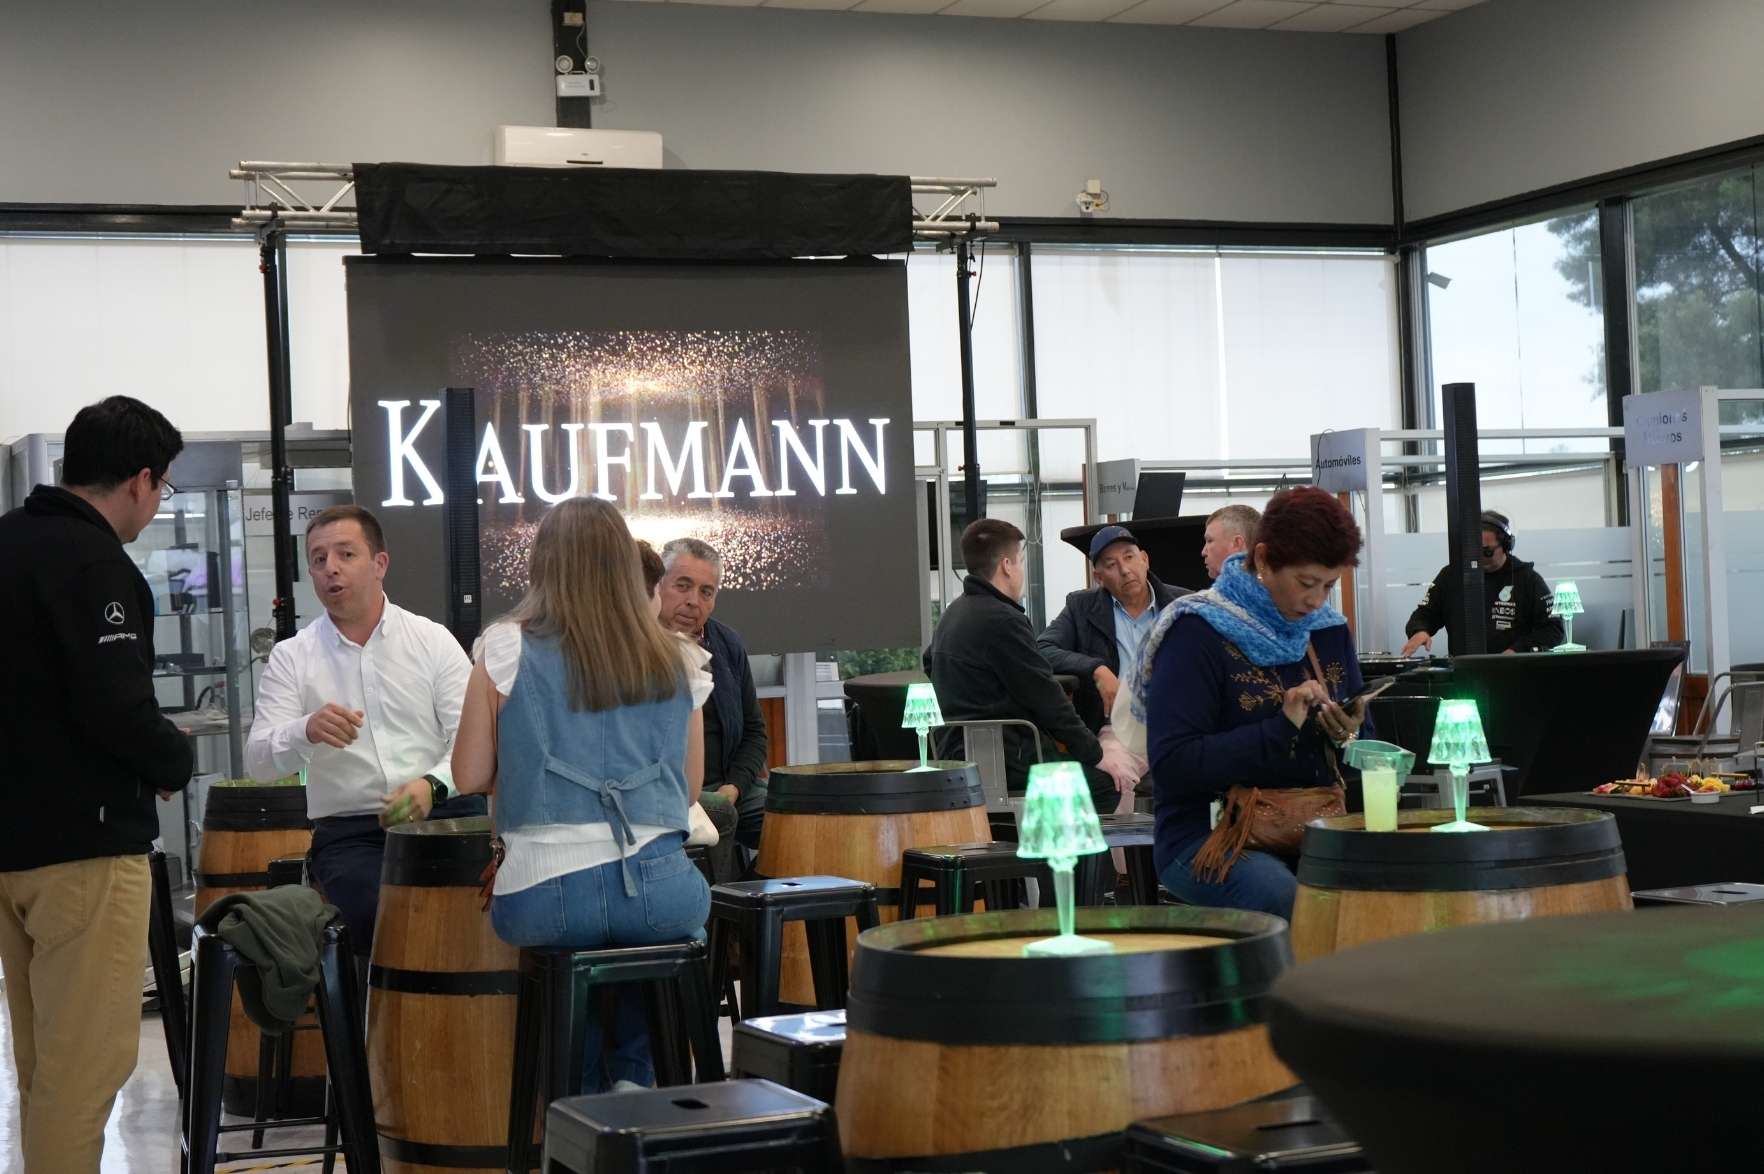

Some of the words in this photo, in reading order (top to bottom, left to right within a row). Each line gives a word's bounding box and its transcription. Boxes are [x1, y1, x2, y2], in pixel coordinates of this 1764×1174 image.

[378, 399, 891, 507] KAUFMANN
[1315, 454, 1362, 470] Automóviles
[246, 505, 274, 521] Jefe
